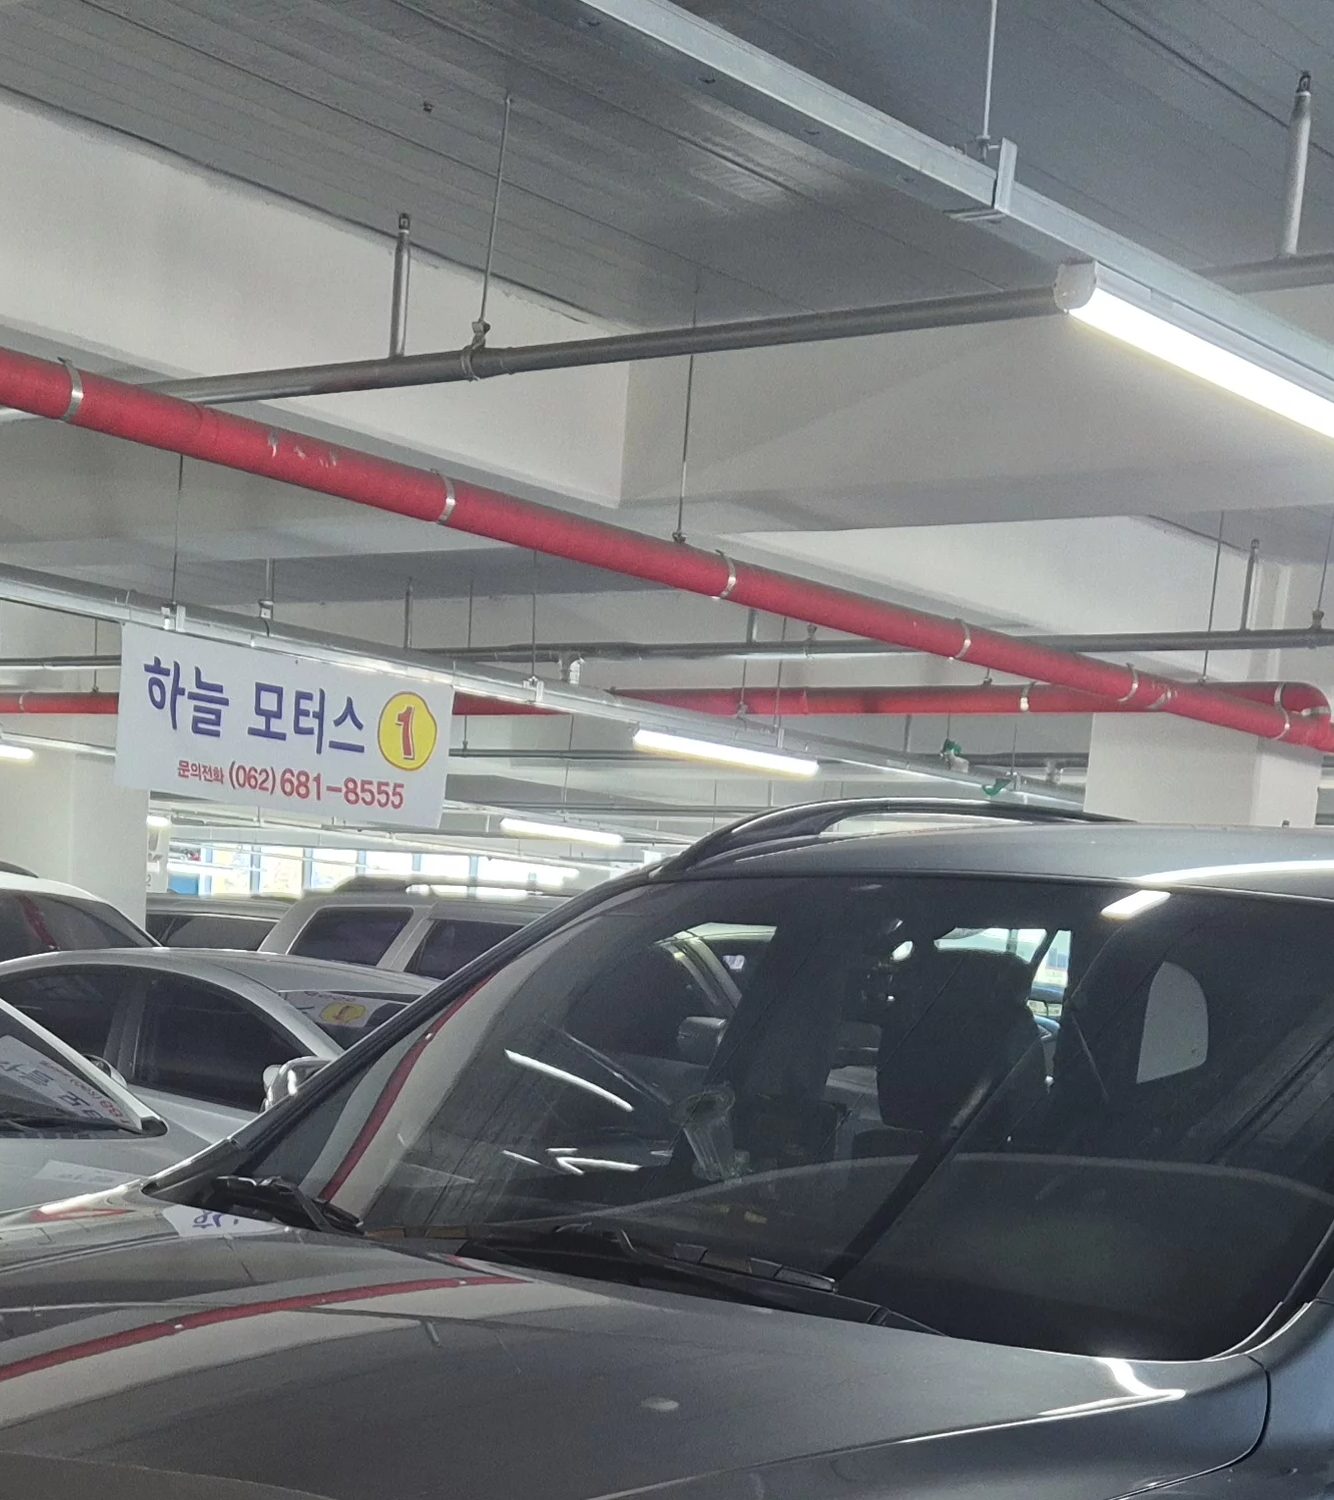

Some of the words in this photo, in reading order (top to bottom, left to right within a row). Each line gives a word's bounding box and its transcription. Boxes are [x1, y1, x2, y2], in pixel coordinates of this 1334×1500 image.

[143, 655, 229, 738] 하늘
[247, 681, 365, 755] 모터스
[177, 760, 224, 785] 문의전화
